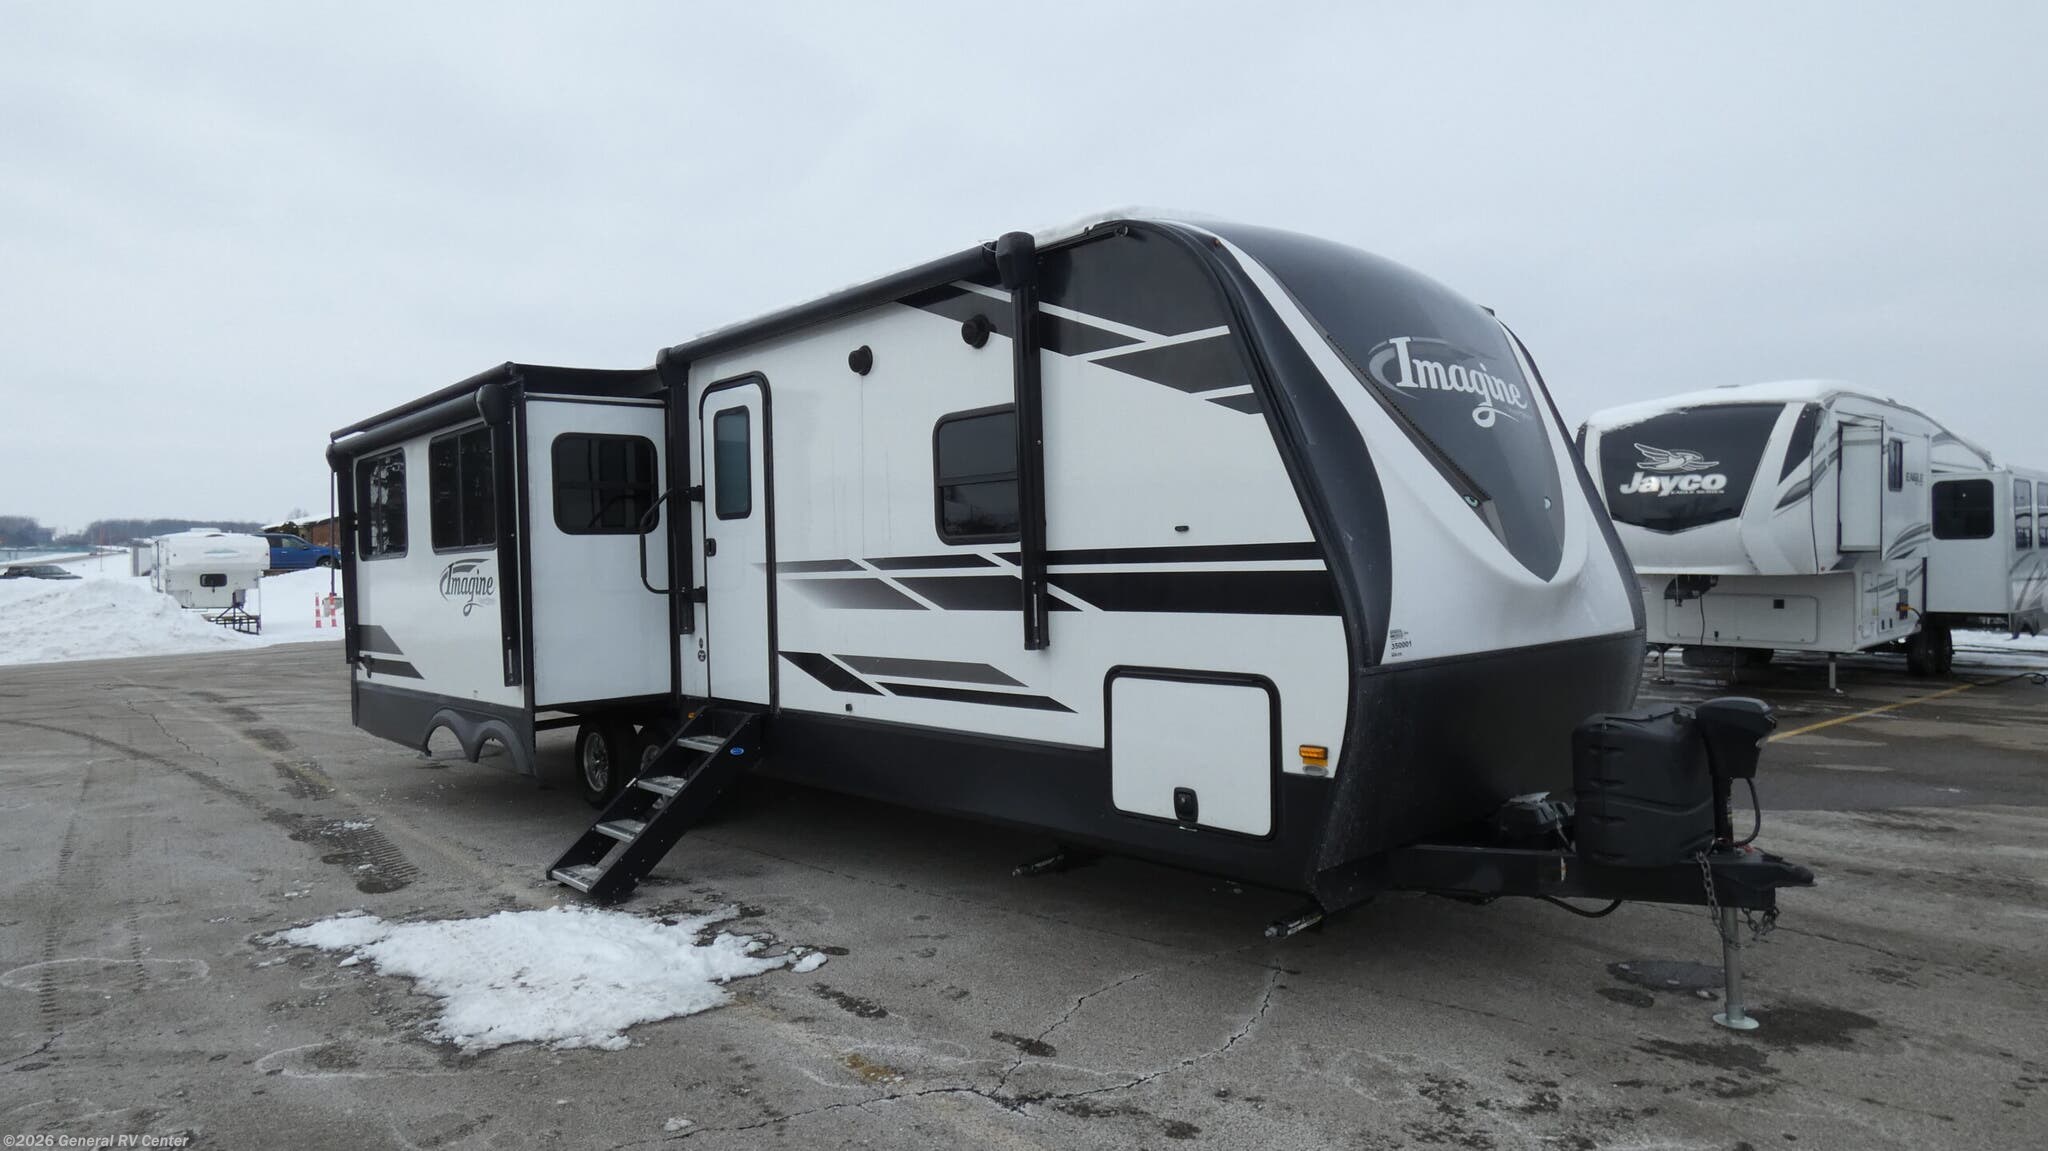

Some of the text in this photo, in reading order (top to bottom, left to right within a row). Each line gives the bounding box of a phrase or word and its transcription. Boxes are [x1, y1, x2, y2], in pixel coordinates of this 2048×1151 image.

[1389, 336, 1528, 428] Imagine
[1620, 471, 1727, 497] Jayco
[445, 562, 495, 616] Imagine
